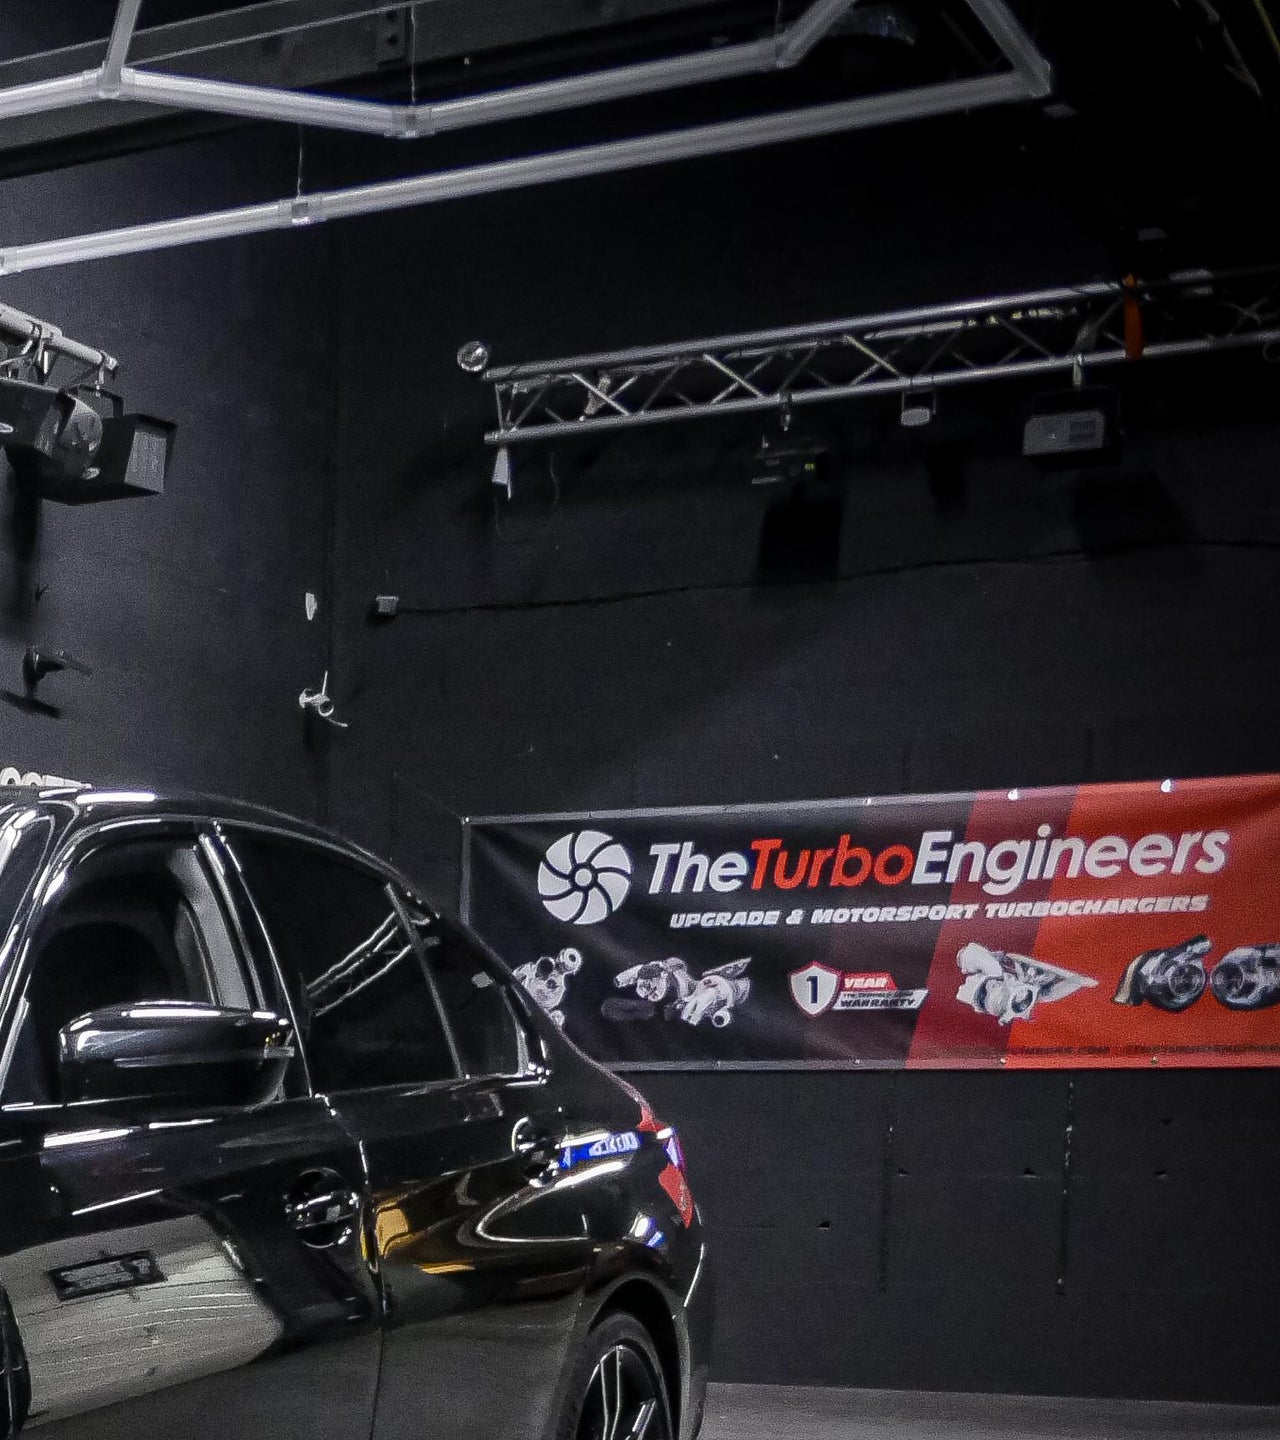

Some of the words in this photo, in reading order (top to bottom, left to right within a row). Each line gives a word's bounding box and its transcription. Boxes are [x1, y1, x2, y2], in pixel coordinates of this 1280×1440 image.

[648, 823, 1231, 895] TheTurboEngineers
[670, 911, 781, 928] UPGRADE
[786, 908, 804, 925] &
[810, 903, 980, 925] MOTORSPORT
[985, 895, 1211, 919] TURBOCHARGERS
[806, 975, 819, 1004] 1
[844, 977, 888, 989] YEAR
[841, 998, 916, 1008] WARRANTY
